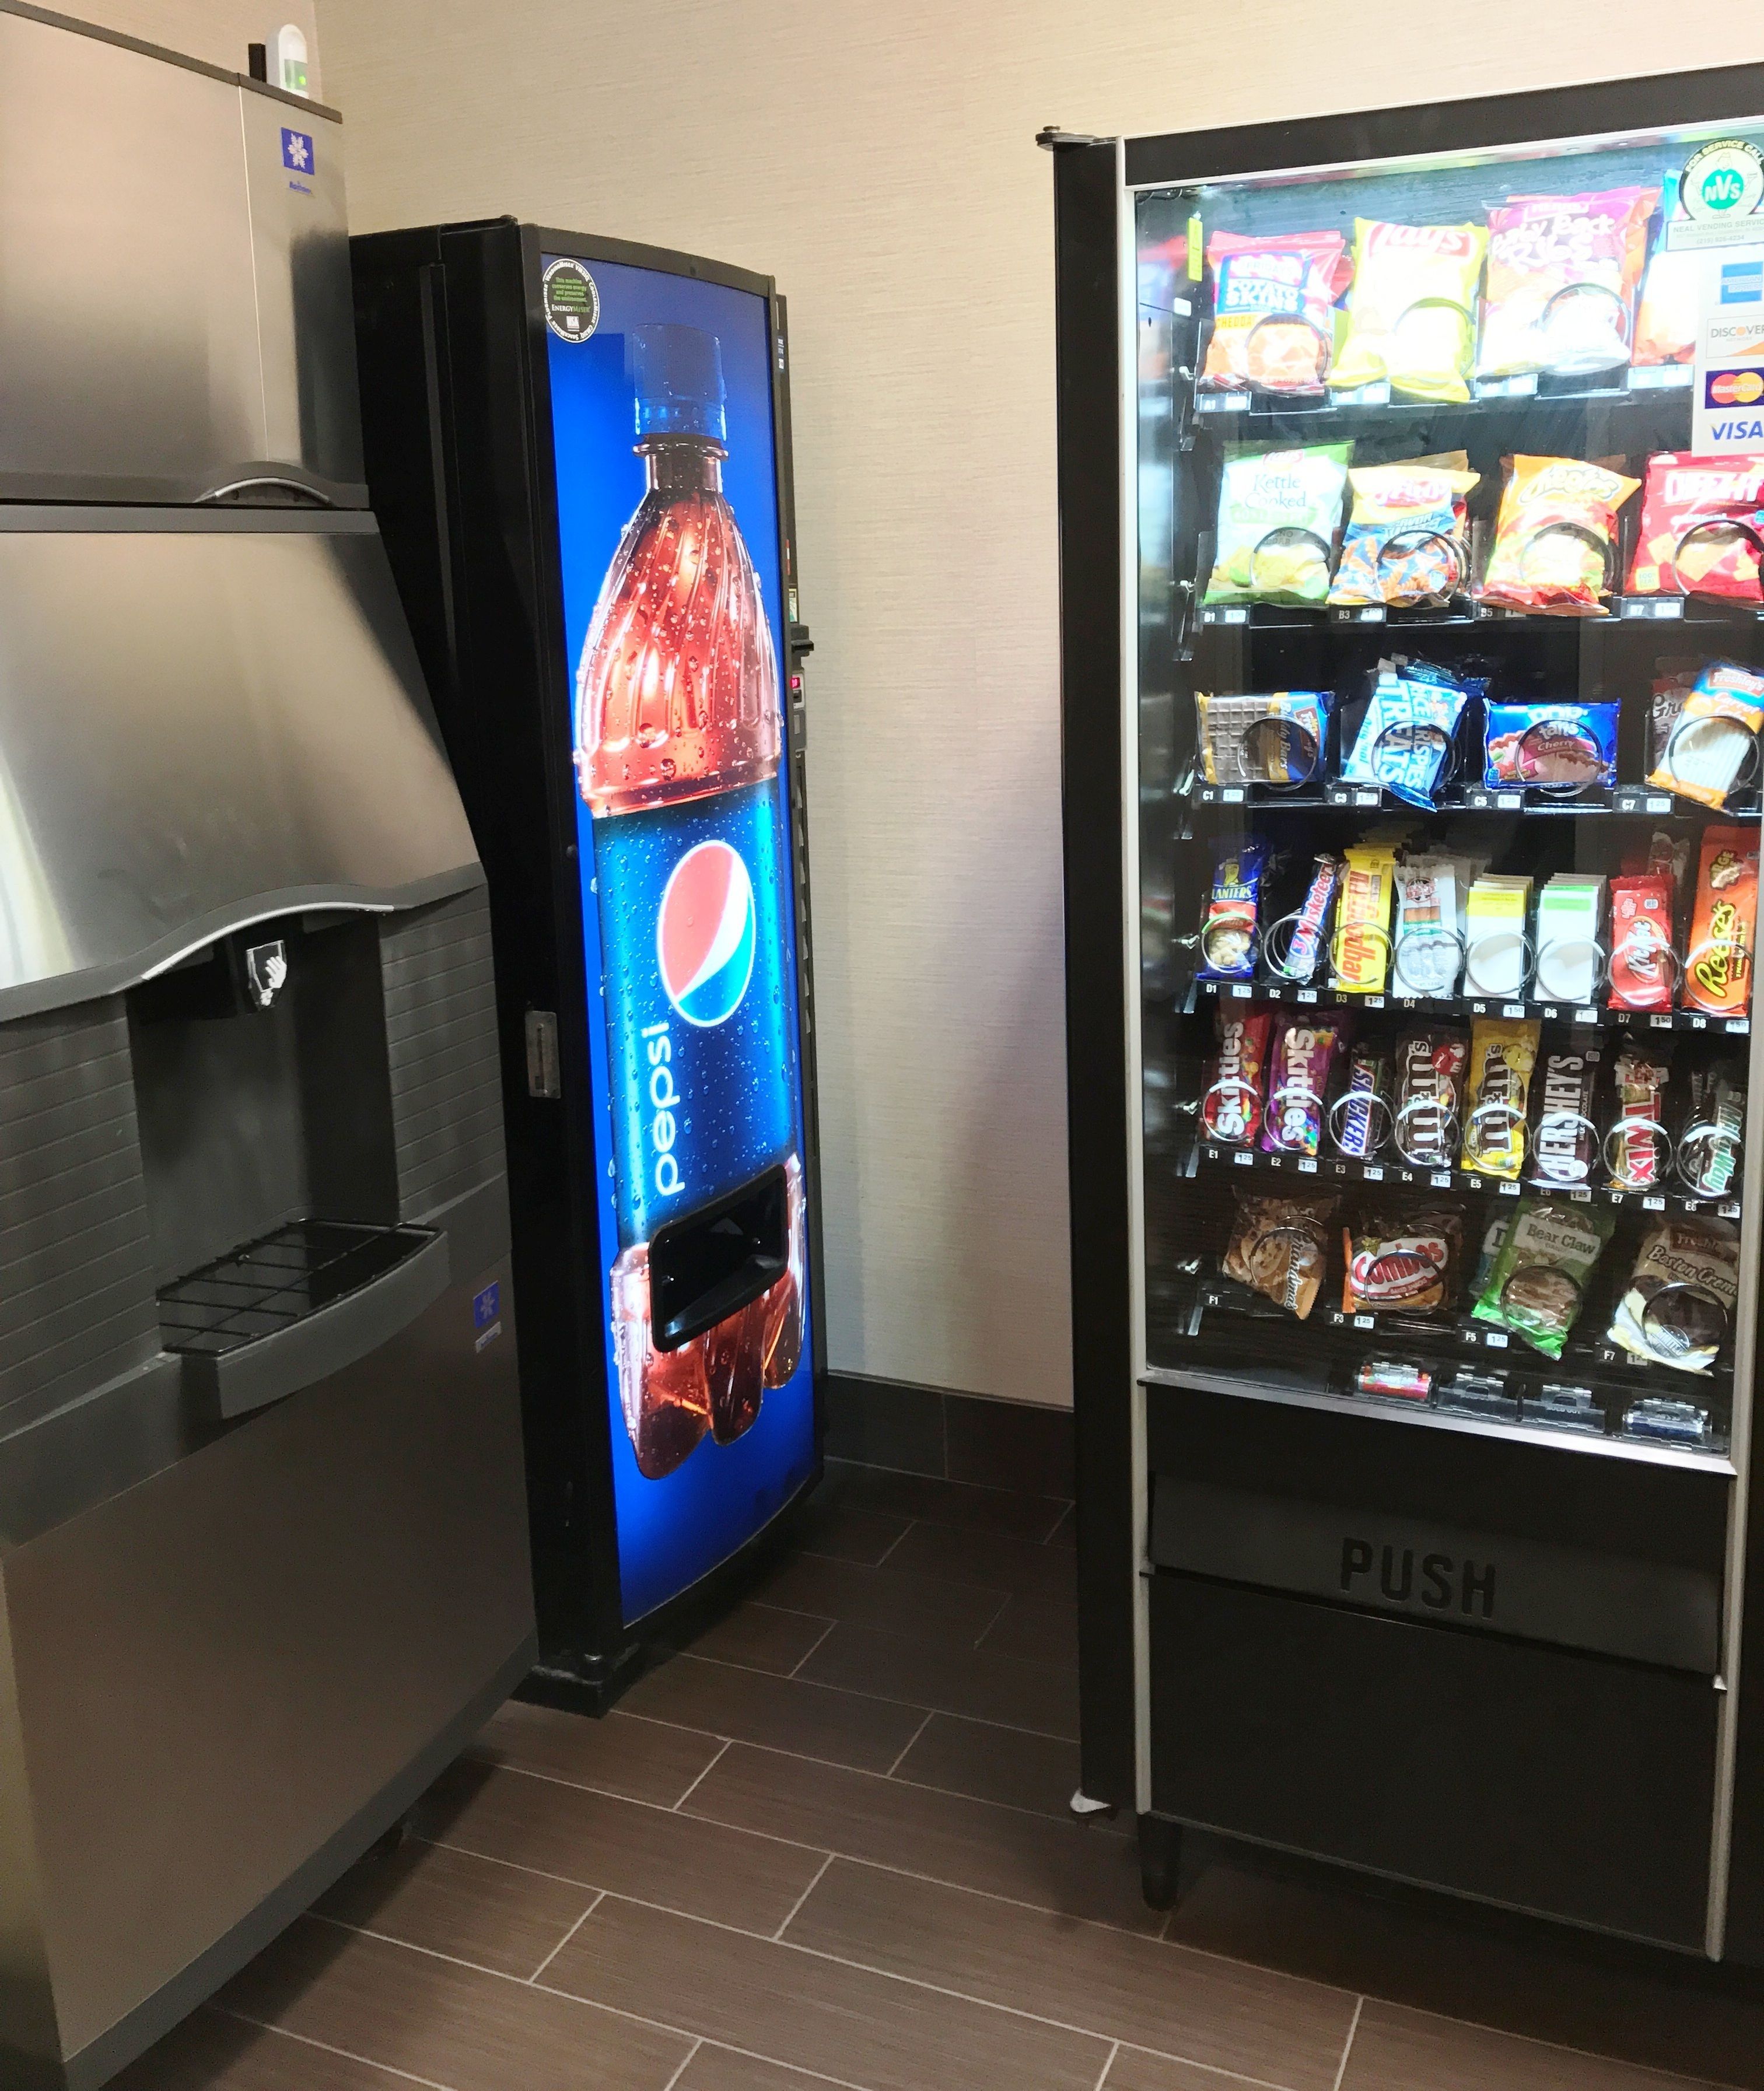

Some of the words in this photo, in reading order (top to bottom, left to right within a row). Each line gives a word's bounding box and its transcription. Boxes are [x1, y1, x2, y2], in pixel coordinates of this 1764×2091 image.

[1685, 153, 1703, 172] FOR
[1702, 140, 1745, 155] SERVICE
[1704, 174, 1741, 202] NVS
[1552, 213, 1615, 236] Back
[1697, 221, 1733, 231] VENDING
[1735, 218, 1764, 228] SERVIC
[1721, 275, 1760, 284] AMERICAN
[1226, 280, 1298, 300] POTATO
[1730, 283, 1763, 292] EXPRESS
[1226, 291, 1298, 312] SKINS
[1712, 383, 1762, 394] MasterCard
[1712, 420, 1763, 440] VISA
[1252, 473, 1301, 493] Kettle
[1245, 491, 1307, 509] Cooked
[1339, 610, 1350, 619] B3
[1480, 607, 1493, 617] B5
[1713, 672, 1764, 692] Freshley's
[1714, 691, 1762, 714] Carrot
[1375, 681, 1413, 784] TREATS
[1538, 721, 1580, 740] tarts
[1538, 740, 1576, 751] Cherry
[1203, 790, 1213, 800] C1
[1335, 793, 1347, 803] C3
[1474, 796, 1487, 806] C5
[1622, 800, 1636, 810] C7
[1211, 885, 1258, 900] LANTERS
[1297, 863, 1336, 943] Musketeer
[1292, 938, 1307, 955] 3
[1695, 899, 1736, 999] Reese's
[1206, 984, 1217, 993] D1
[1269, 989, 1281, 999] D2
[1336, 993, 1348, 1003] D3
[1404, 999, 1415, 1008] D4
[1473, 1003, 1486, 1014] D5
[1544, 1008, 1558, 1018] D6
[1618, 1013, 1631, 1024] D7
[1693, 1018, 1707, 1029] D8
[640, 1022, 685, 1196] pepsi
[1625, 1092, 1661, 1182] TWIX
[1209, 1149, 1218, 1159] E1
[1271, 1157, 1281, 1167] E2
[1335, 1164, 1346, 1174] E3
[1702, 1151, 1736, 1191] Way
[1402, 1171, 1413, 1182] E4
[1471, 1179, 1481, 1189] E5
[1612, 1193, 1623, 1204] E7
[1527, 1223, 1560, 1244] Bear
[1561, 1234, 1597, 1255] Claw
[1285, 1225, 1314, 1309] Grandma's
[1355, 1242, 1444, 1285] Combos
[1646, 1244, 1699, 1280] Boston
[1209, 1295, 1218, 1305] F1
[1334, 1313, 1344, 1323] F3
[1465, 1332, 1476, 1342] F5
[1604, 1350, 1615, 1361] F7
[1340, 1536, 1497, 1621] PUSH
